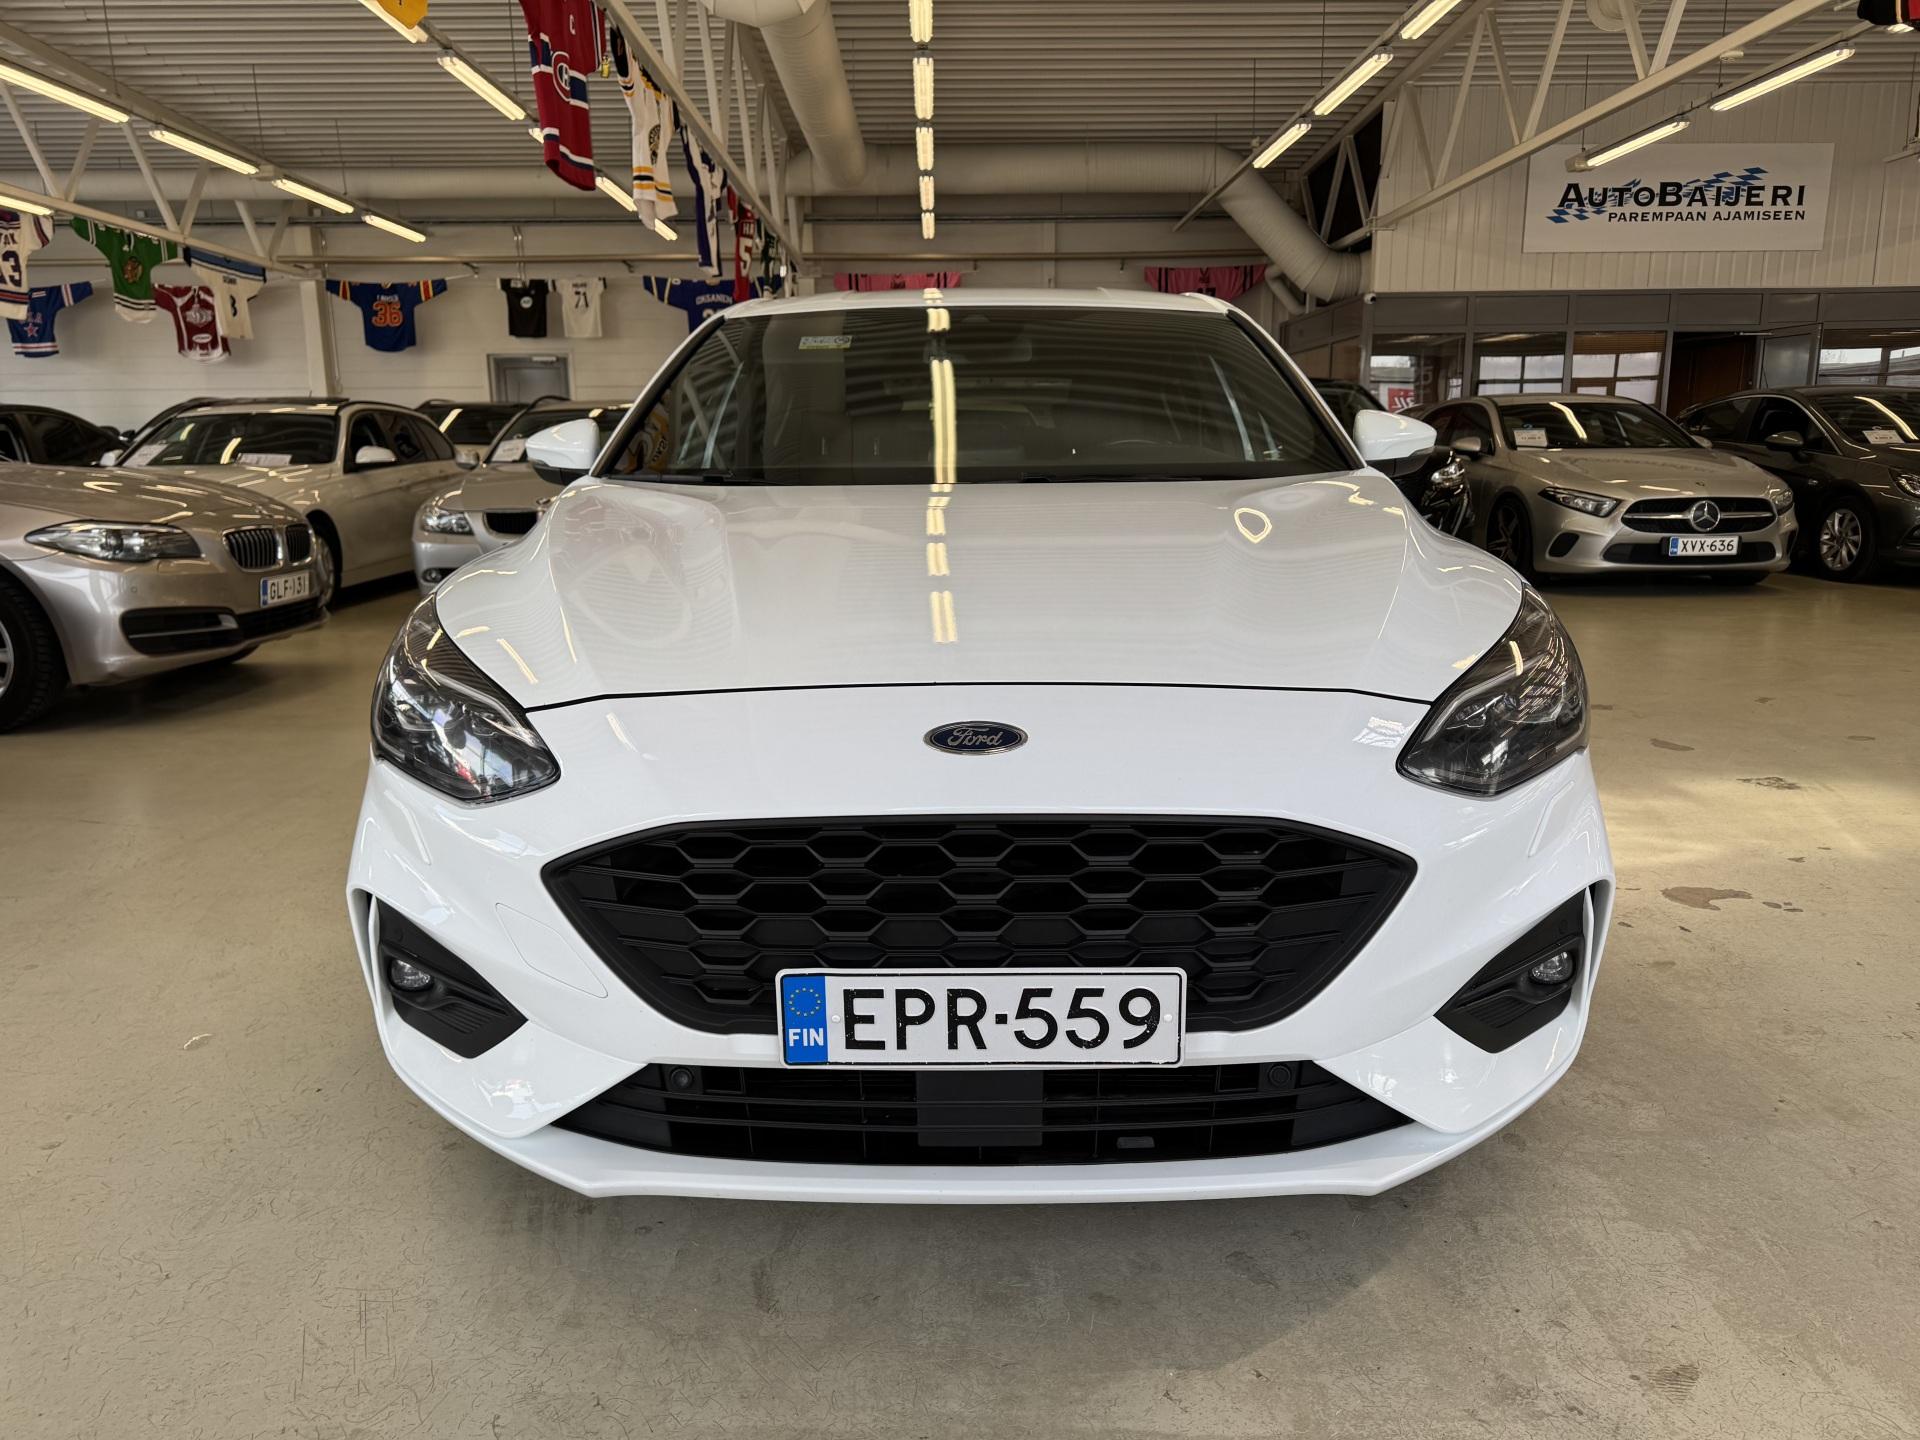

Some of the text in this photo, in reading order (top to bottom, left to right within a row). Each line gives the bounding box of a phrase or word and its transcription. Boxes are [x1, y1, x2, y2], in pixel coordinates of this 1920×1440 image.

[1608, 210, 1806, 222] PAREMPAAN AJAMISEEN
[371, 301, 404, 328] 36
[1681, 539, 1734, 552] XVX-636
[270, 575, 306, 600] GLF-131
[947, 726, 1003, 746] Ford
[842, 986, 1161, 1051] EPR-559
[788, 1027, 824, 1047] FIN
